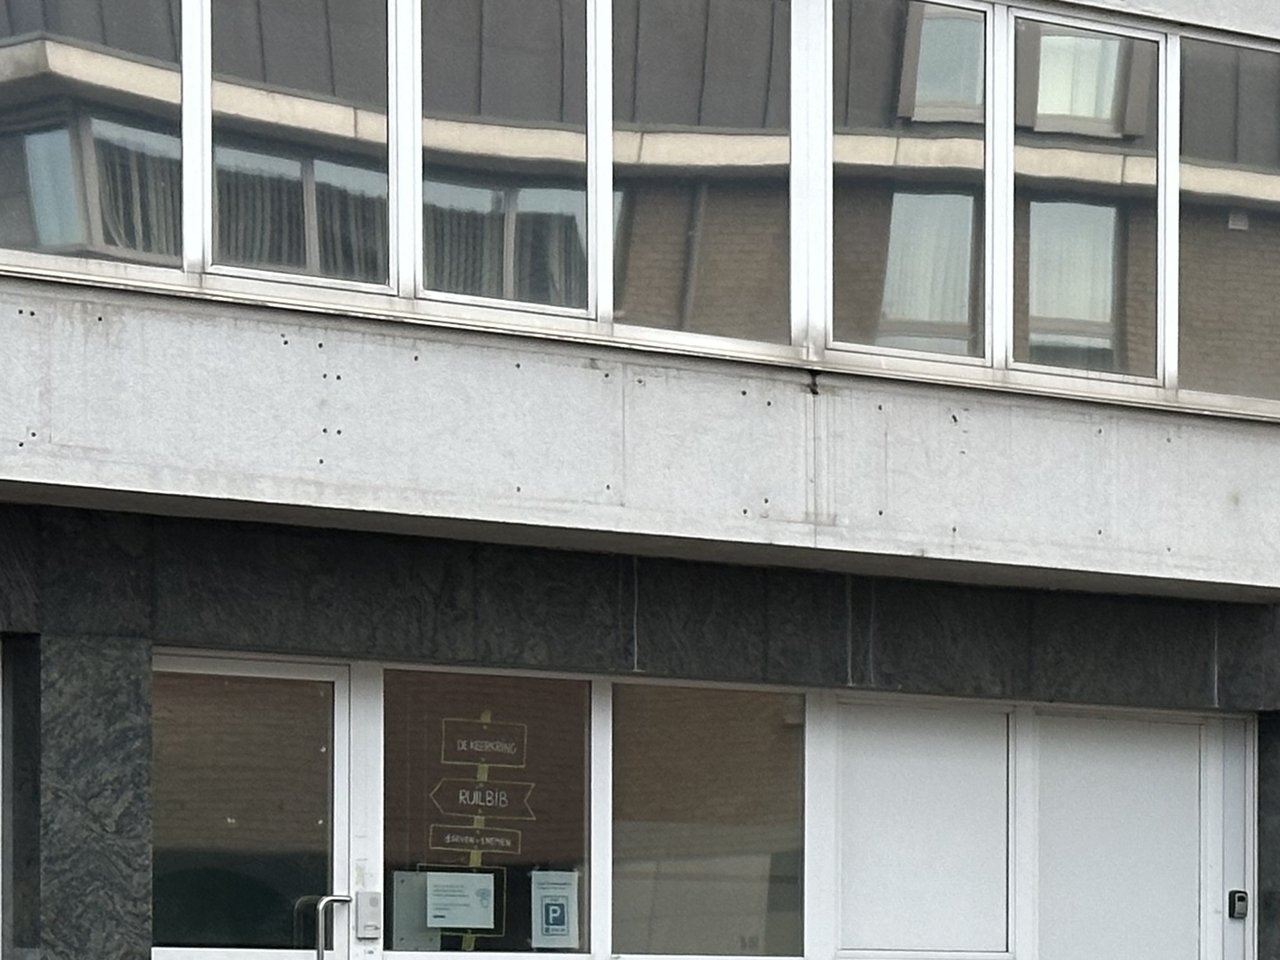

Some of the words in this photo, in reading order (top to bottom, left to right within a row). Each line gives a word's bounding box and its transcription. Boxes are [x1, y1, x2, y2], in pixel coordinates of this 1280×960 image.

[456, 740, 468, 751] DE
[458, 788, 509, 808] RUILBIB
[549, 905, 562, 924] P
